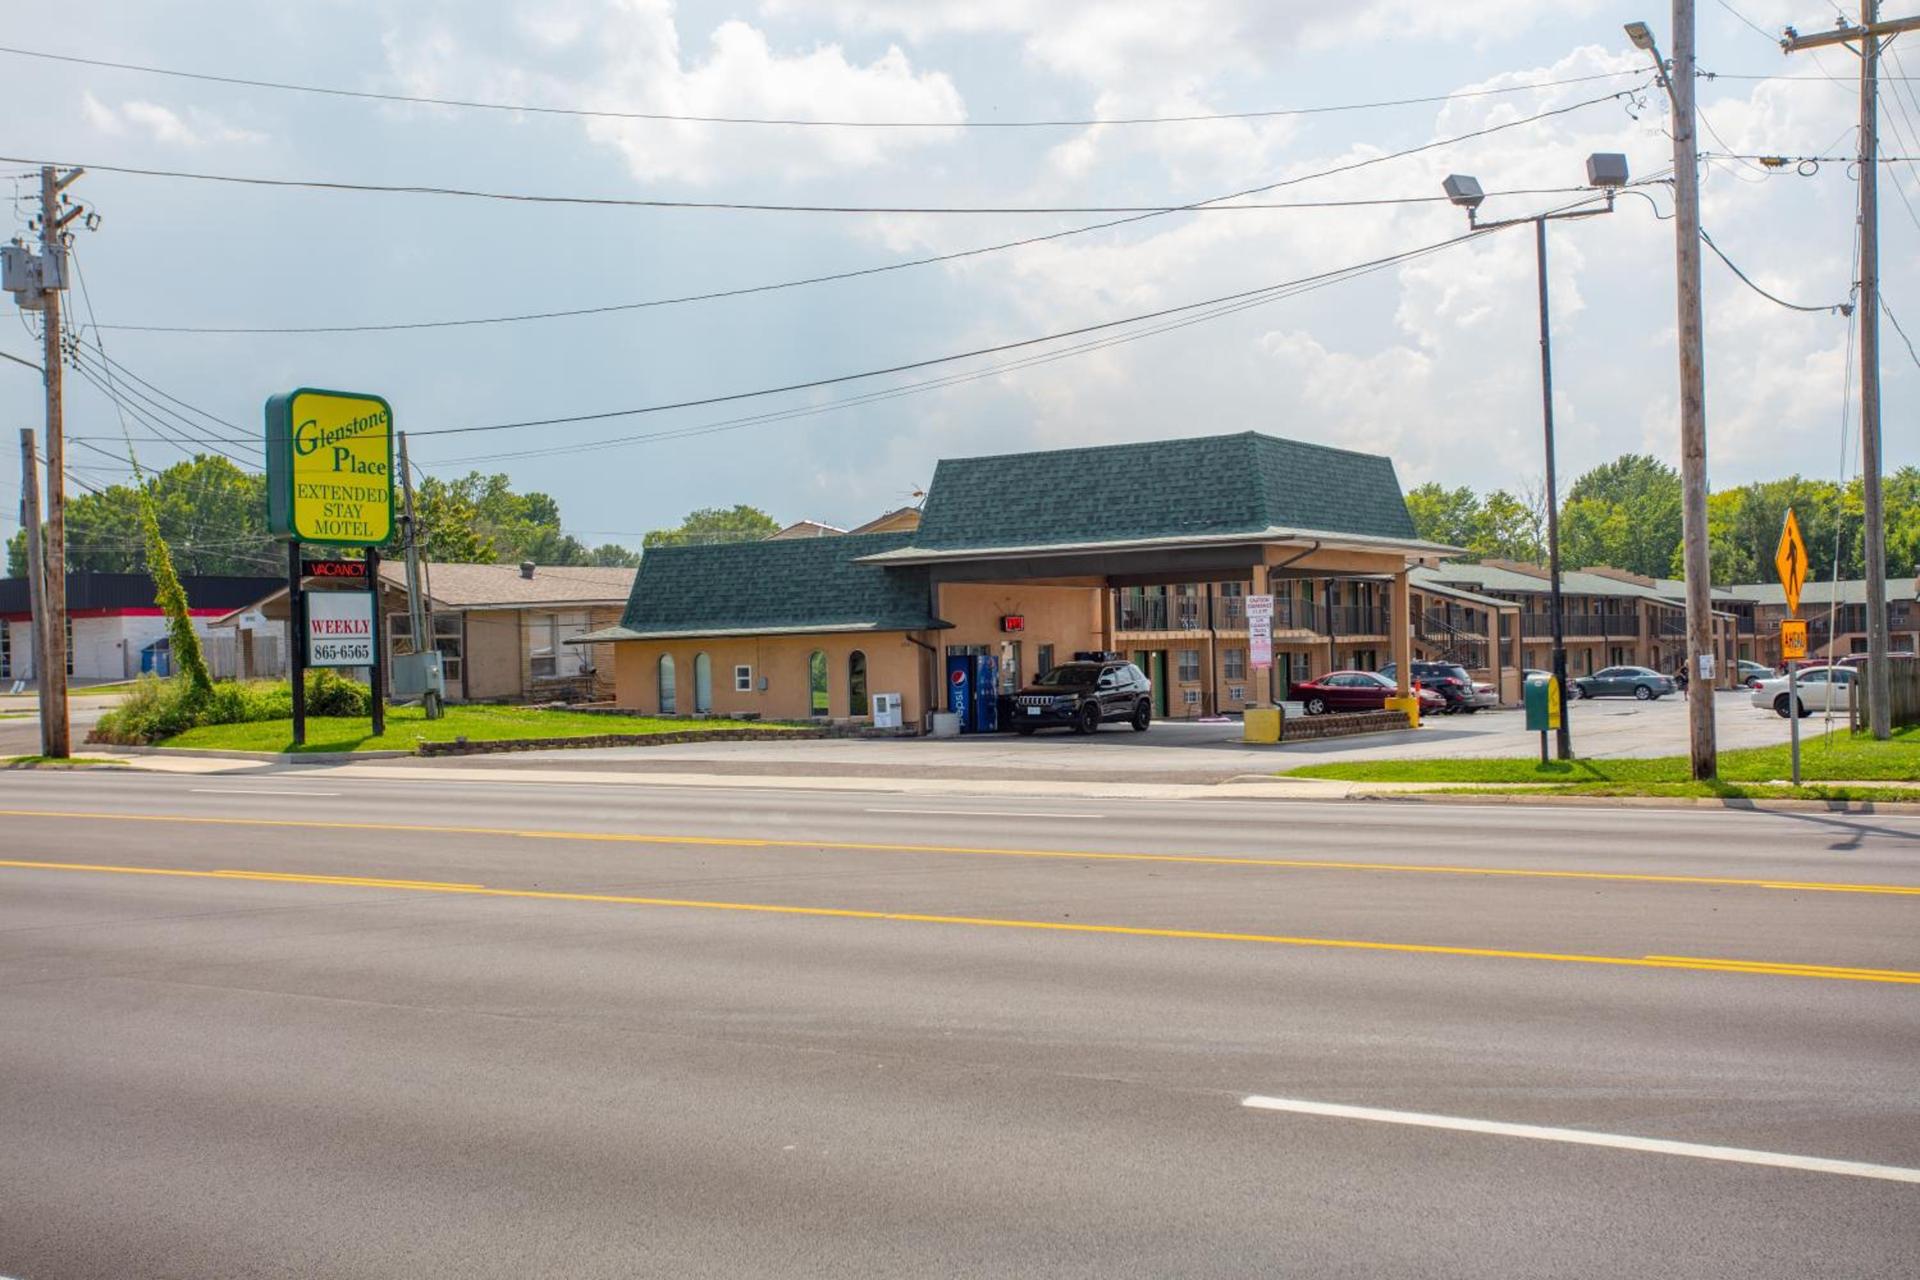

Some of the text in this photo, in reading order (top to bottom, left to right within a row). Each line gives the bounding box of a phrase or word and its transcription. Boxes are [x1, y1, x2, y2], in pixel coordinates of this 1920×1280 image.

[295, 410, 387, 456] Glenstone
[332, 447, 387, 475] Place
[297, 484, 388, 503] EXTENDED
[323, 503, 364, 519] STAY
[314, 519, 374, 537] MOTEL
[311, 563, 366, 576] VACANCY
[312, 619, 370, 634] WEEKLY
[314, 644, 369, 660] 865-6565
